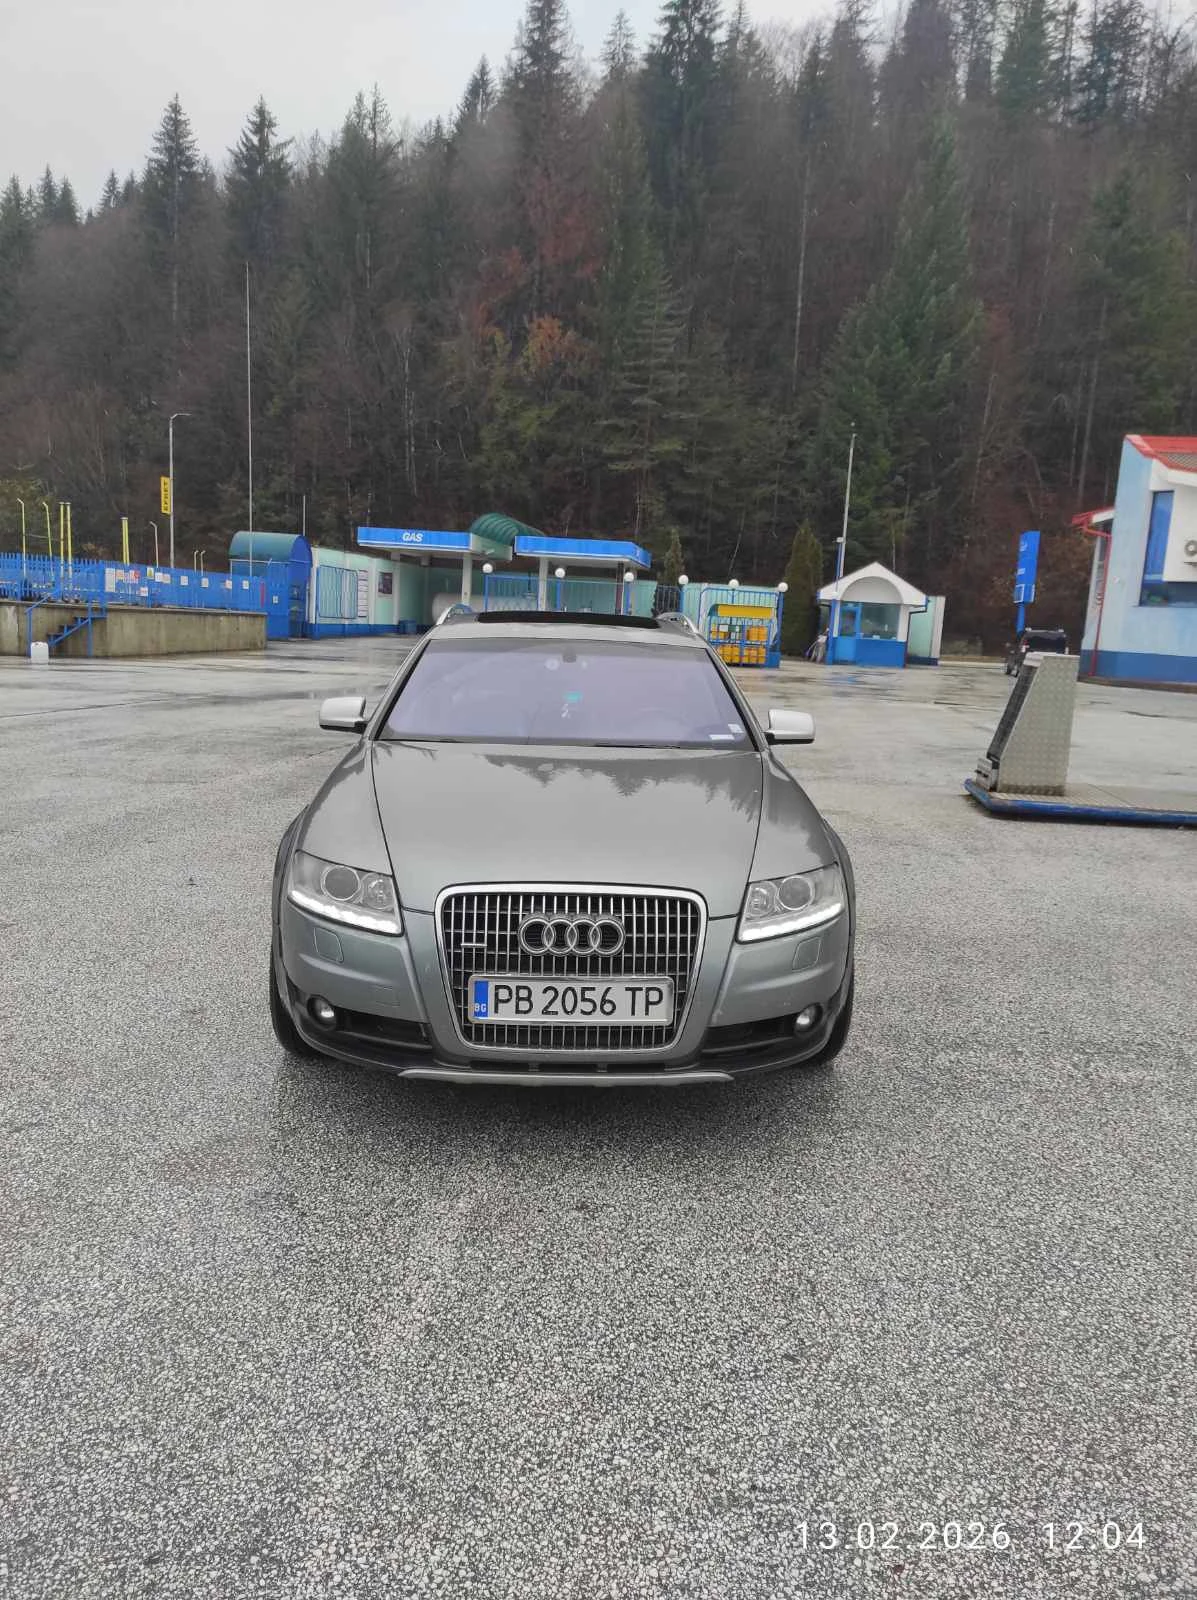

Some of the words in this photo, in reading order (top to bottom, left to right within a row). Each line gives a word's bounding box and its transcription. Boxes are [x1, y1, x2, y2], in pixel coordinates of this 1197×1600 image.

[402, 532, 424, 543] GAS
[493, 984, 534, 1015] PB
[541, 986, 617, 1016] 2056
[624, 986, 664, 1016] TP
[474, 1004, 487, 1013] BG
